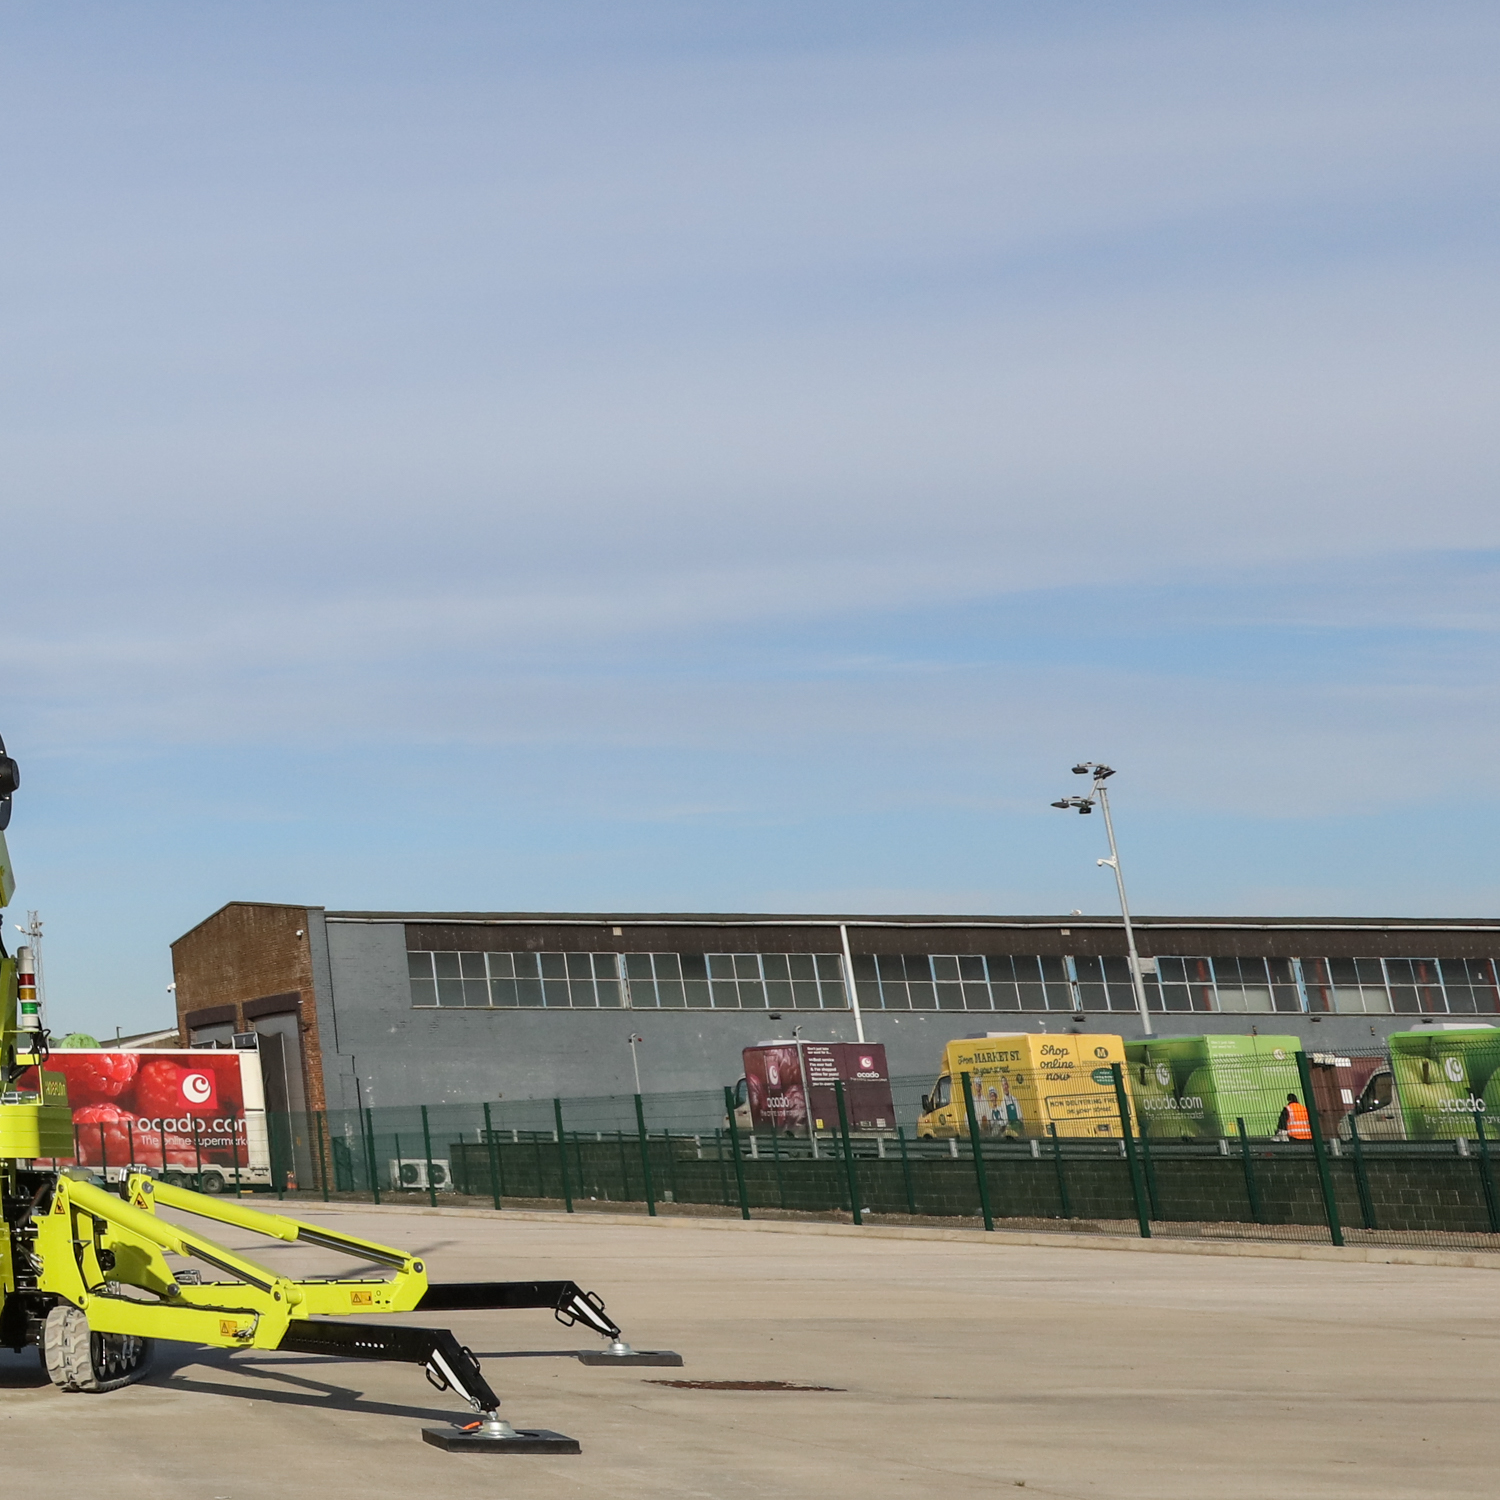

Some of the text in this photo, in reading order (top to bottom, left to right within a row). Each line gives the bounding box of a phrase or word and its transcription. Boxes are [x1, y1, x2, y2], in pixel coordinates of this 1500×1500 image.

[1040, 1045, 1069, 1056] Shop
[974, 1051, 1010, 1064] MARKET
[1040, 1059, 1074, 1070] online
[1045, 1073, 1070, 1081] now
[1143, 1093, 1204, 1110] ocado.com
[1437, 1093, 1487, 1112] ocado
[141, 1135, 159, 1146] The
[194, 1136, 249, 1148] upermrk
